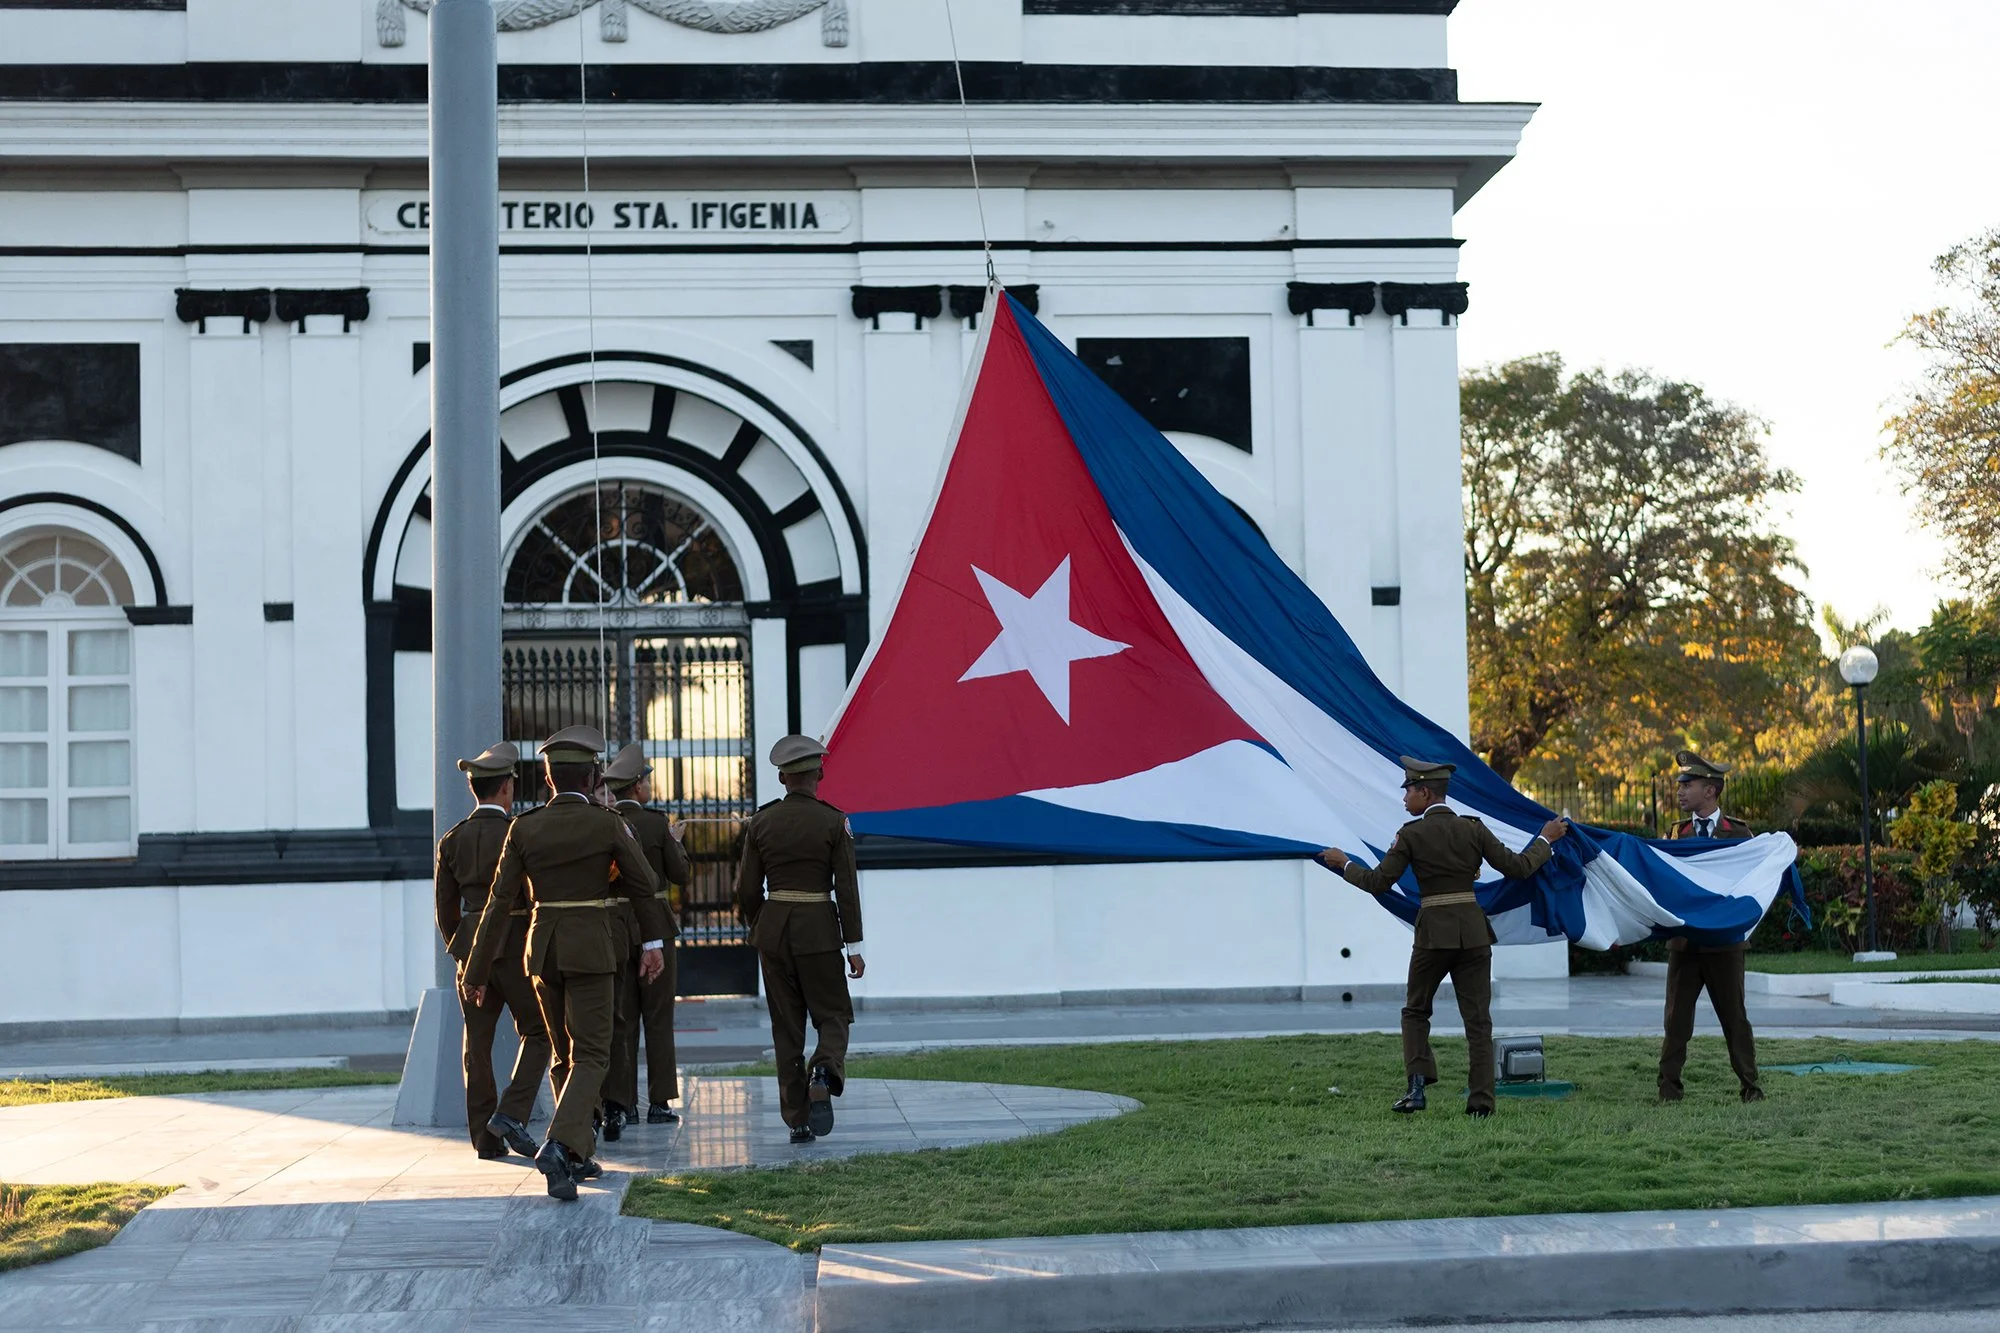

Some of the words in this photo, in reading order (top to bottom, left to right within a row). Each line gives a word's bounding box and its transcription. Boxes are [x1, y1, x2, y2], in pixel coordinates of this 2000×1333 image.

[397, 202, 594, 229] CETERIO
[614, 202, 678, 229] STA.
[691, 202, 819, 229] IFIGENIA
